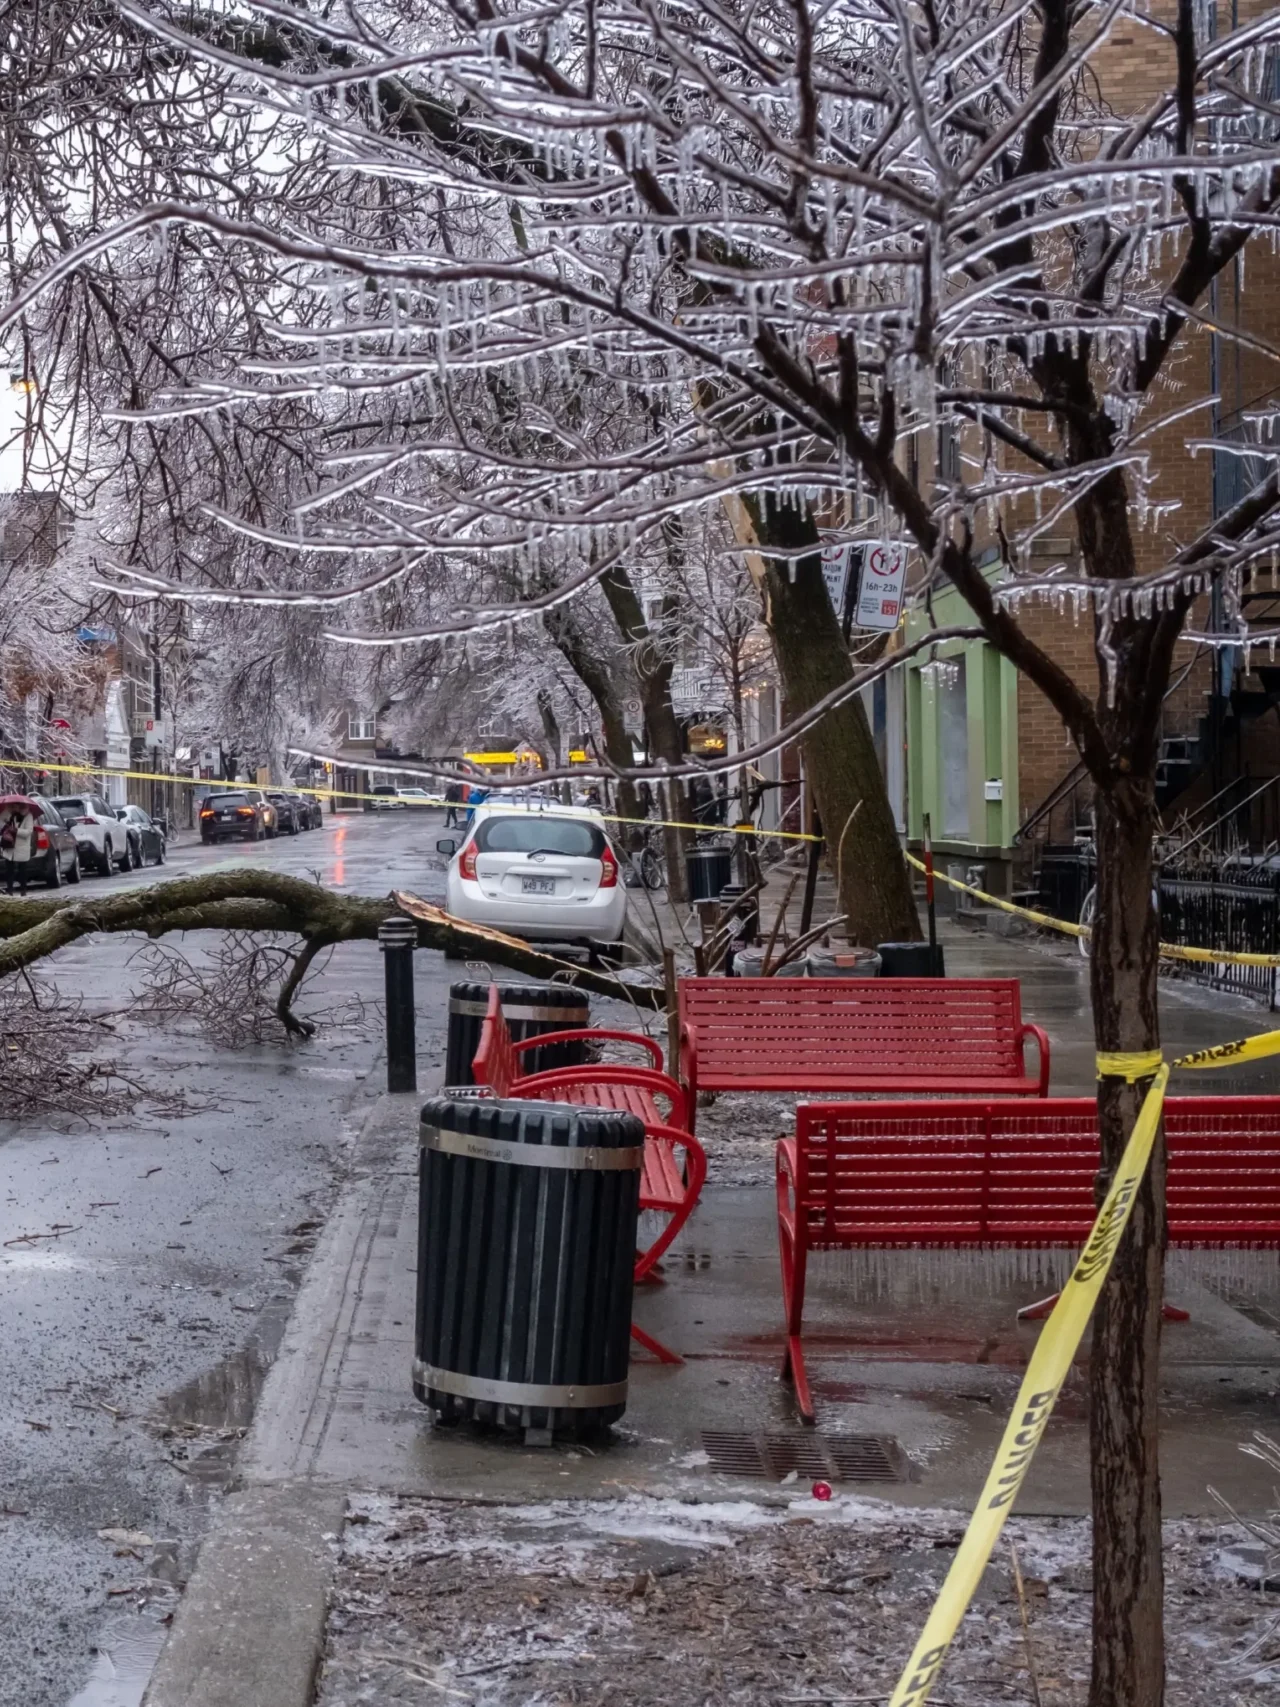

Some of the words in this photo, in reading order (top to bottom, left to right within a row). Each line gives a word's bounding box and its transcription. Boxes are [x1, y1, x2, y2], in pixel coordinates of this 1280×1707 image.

[866, 582, 898, 593] 16h-23h
[884, 605, 897, 615] 151
[987, 1387, 1056, 1510] DANGER
